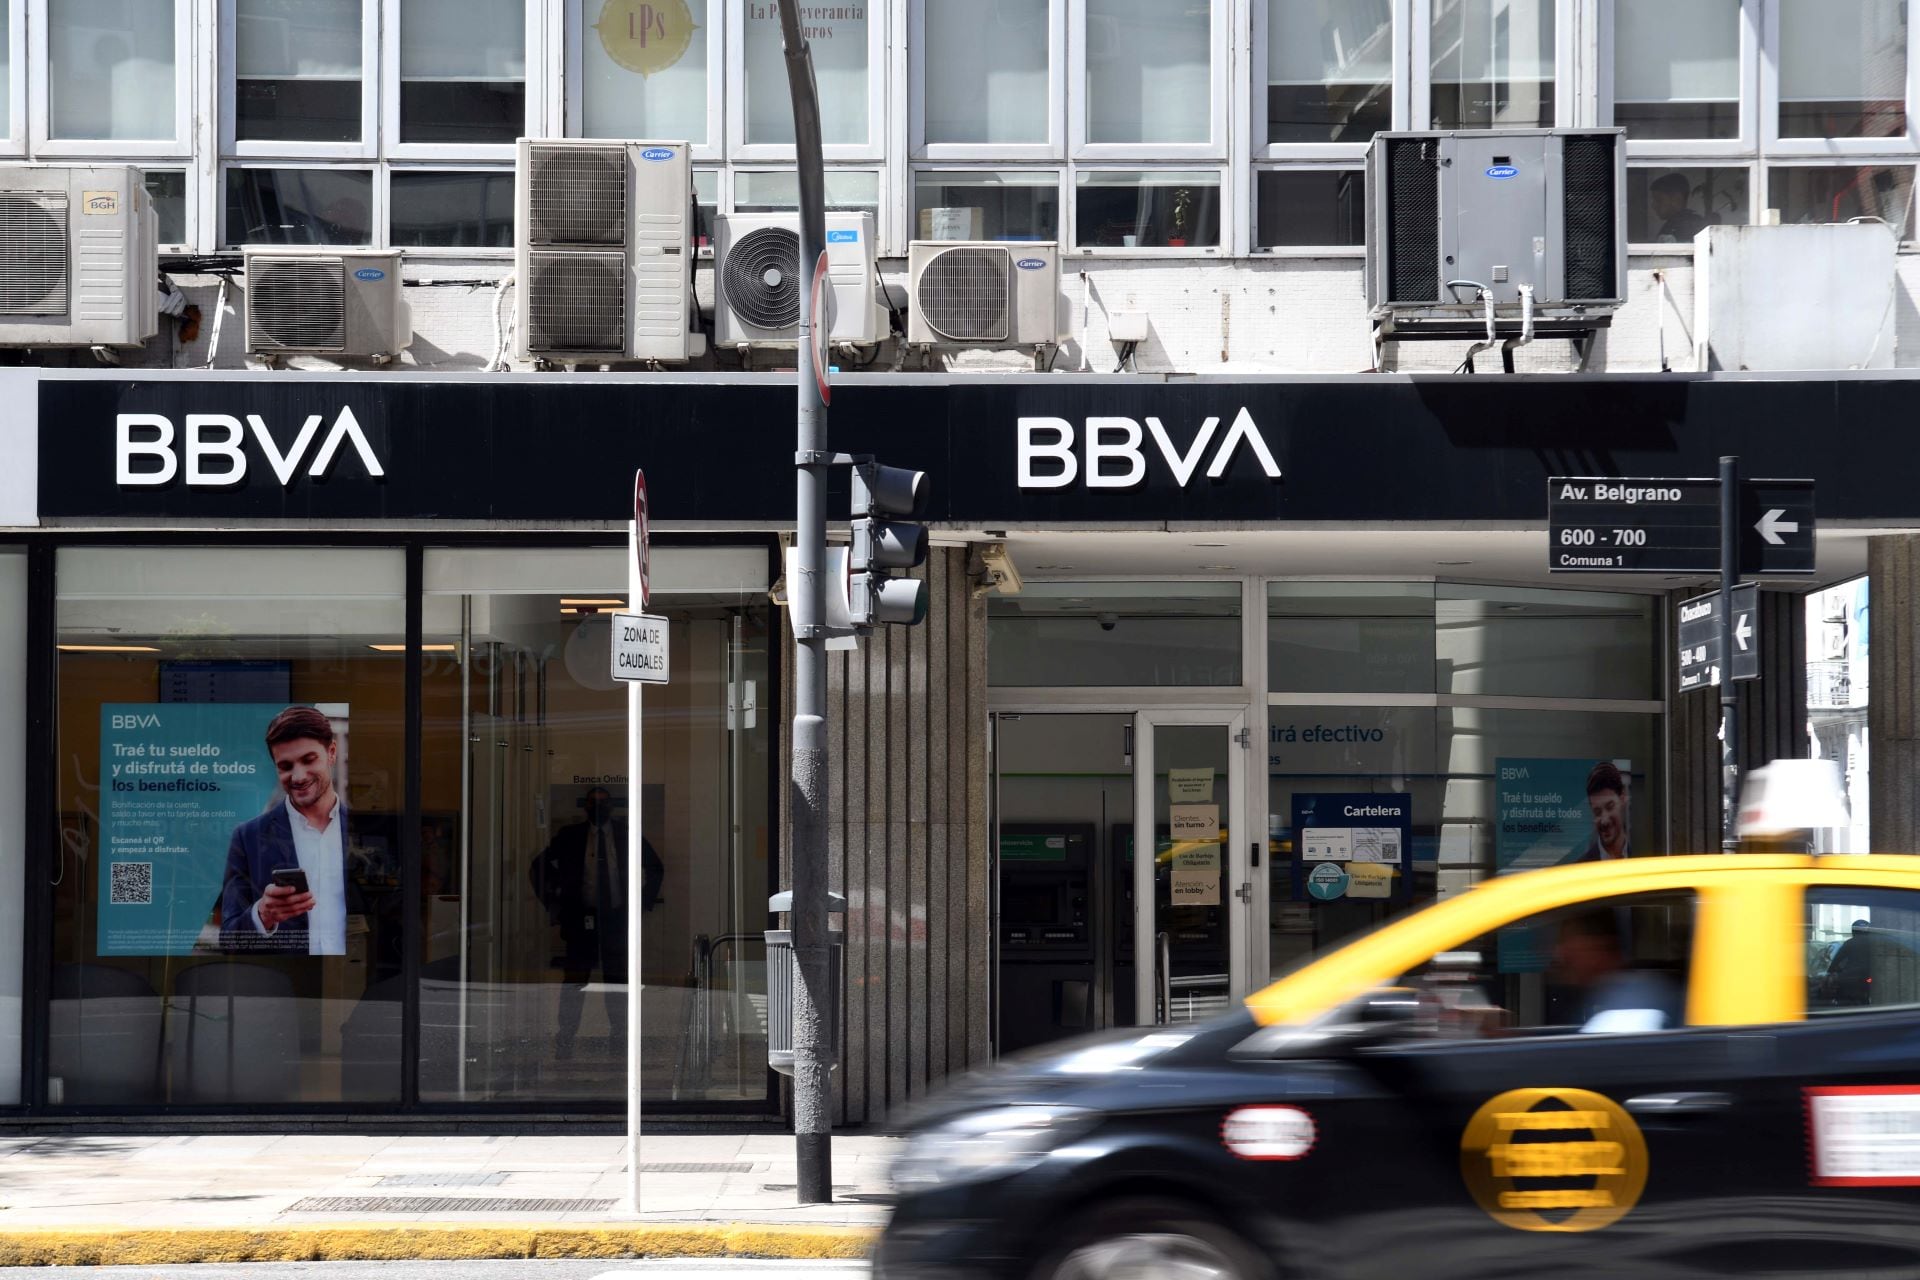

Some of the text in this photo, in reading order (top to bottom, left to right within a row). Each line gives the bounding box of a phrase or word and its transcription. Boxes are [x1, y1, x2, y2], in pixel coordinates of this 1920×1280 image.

[750, 4, 864, 20] La Peverancia
[630, 4, 665, 48] LPS
[116, 405, 384, 485] BBVA
[1018, 406, 1282, 487] BBVA
[1560, 485, 1681, 504] Av. Belgrano
[1561, 529, 1595, 545] 600
[1612, 530, 1646, 546] 700
[1560, 554, 1623, 566] Comuna 1
[624, 627, 659, 644] ZONA DE
[620, 653, 663, 670] CAUDALES
[113, 714, 161, 729] BBVA
[1268, 725, 1383, 742] irá efectivo
[113, 744, 220, 756] Traé tu sueldo
[112, 762, 256, 777] y disfrutá de todos
[1502, 768, 1529, 780] BBVA
[112, 778, 221, 792] los beneficios.
[574, 775, 600, 784] Banca
[1502, 792, 1562, 803] Traé tu sueldo
[112, 801, 155, 809] Bonificación
[157, 801, 165, 809] de
[1344, 806, 1401, 816] Cartelera
[176, 811, 199, 819] tarjeta
[211, 810, 236, 818] crédito
[1502, 807, 1582, 820] y disfrutá de todos
[1503, 823, 1516, 833] los
[112, 836, 143, 844] Escaneá
[118, 846, 146, 854] empezá
